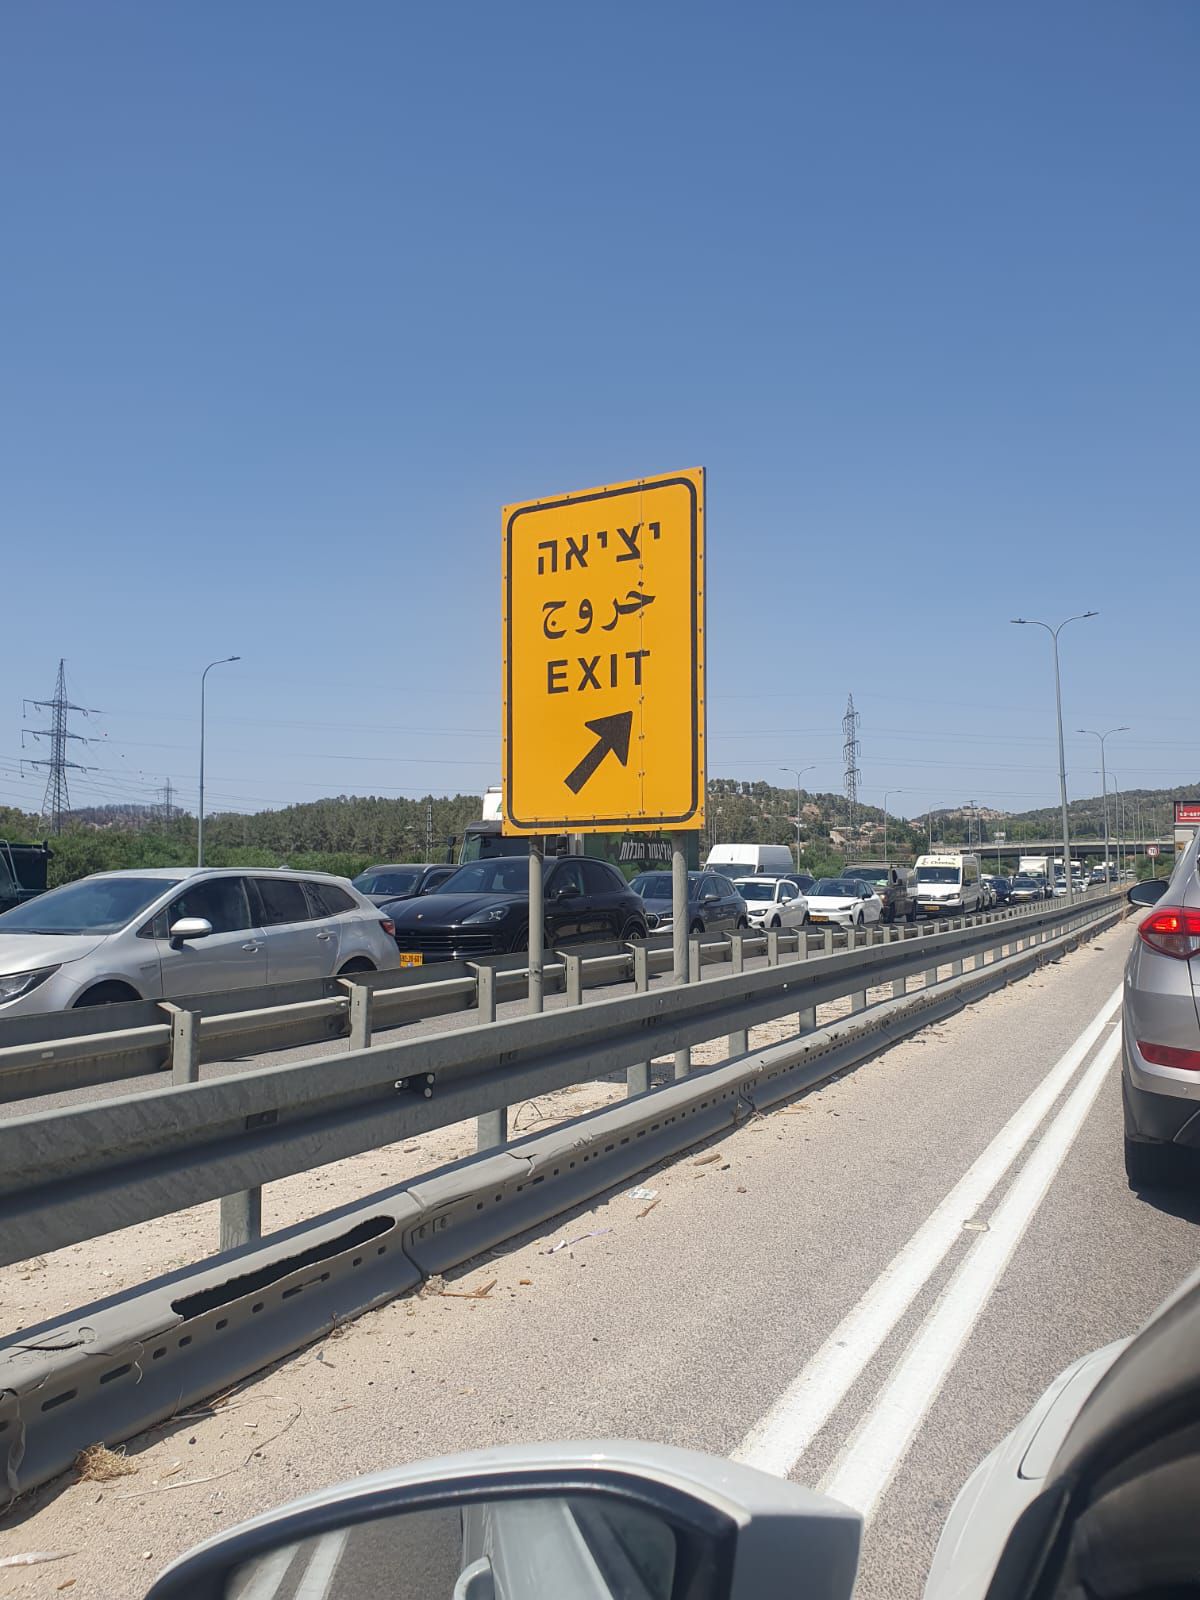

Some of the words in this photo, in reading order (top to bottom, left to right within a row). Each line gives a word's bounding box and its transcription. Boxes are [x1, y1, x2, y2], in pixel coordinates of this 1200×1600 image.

[537, 521, 661, 575] יציאה
[542, 581, 656, 640] خروج
[547, 650, 651, 694] EXIT
[619, 839, 646, 860] הובלות
